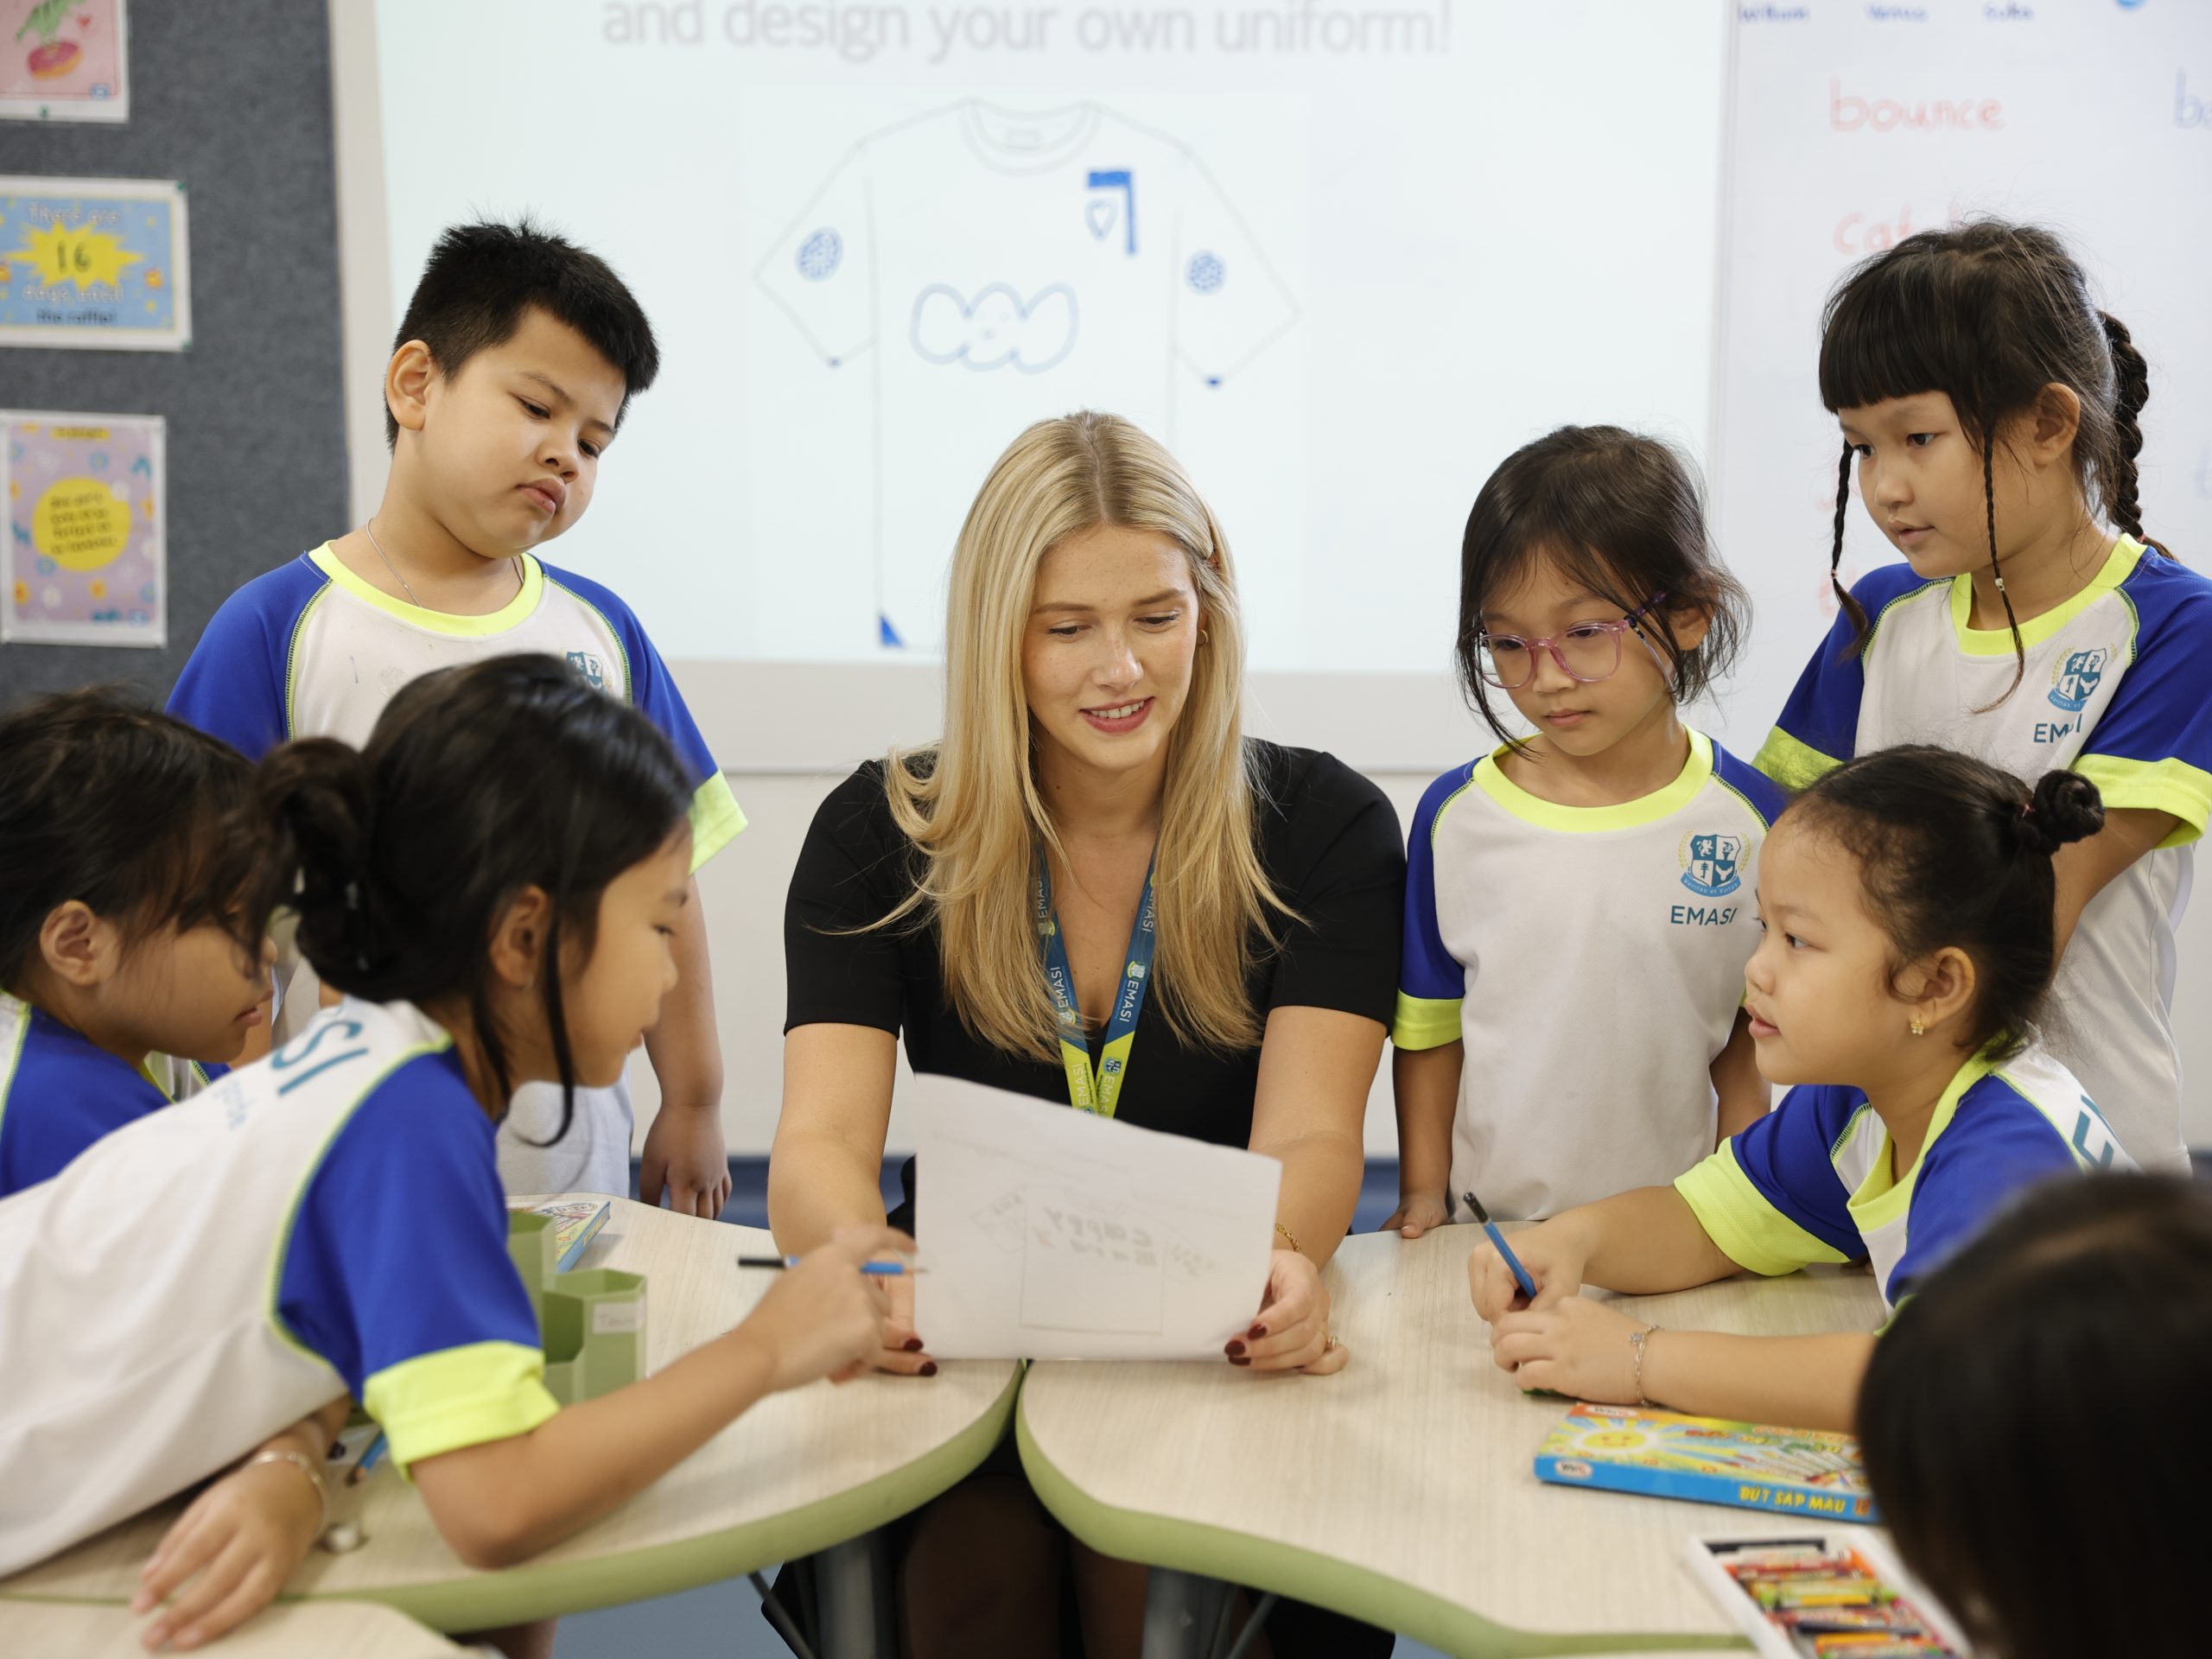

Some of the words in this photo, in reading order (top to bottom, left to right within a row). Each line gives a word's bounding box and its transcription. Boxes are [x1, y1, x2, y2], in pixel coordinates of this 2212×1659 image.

[601, 0, 703, 46] and
[722, 0, 911, 64] design
[928, 5, 1060, 65] your
[1076, 7, 1198, 52] own
[1214, 0, 1454, 54] uniform!
[1829, 75, 2005, 132] bounce
[57, 240, 92, 274] 16
[1670, 906, 1738, 925] EMASI
[1050, 967, 1069, 1008] EMASI
[1119, 980, 1140, 1022] EMASI
[1071, 1064, 1090, 1106] EMASI
